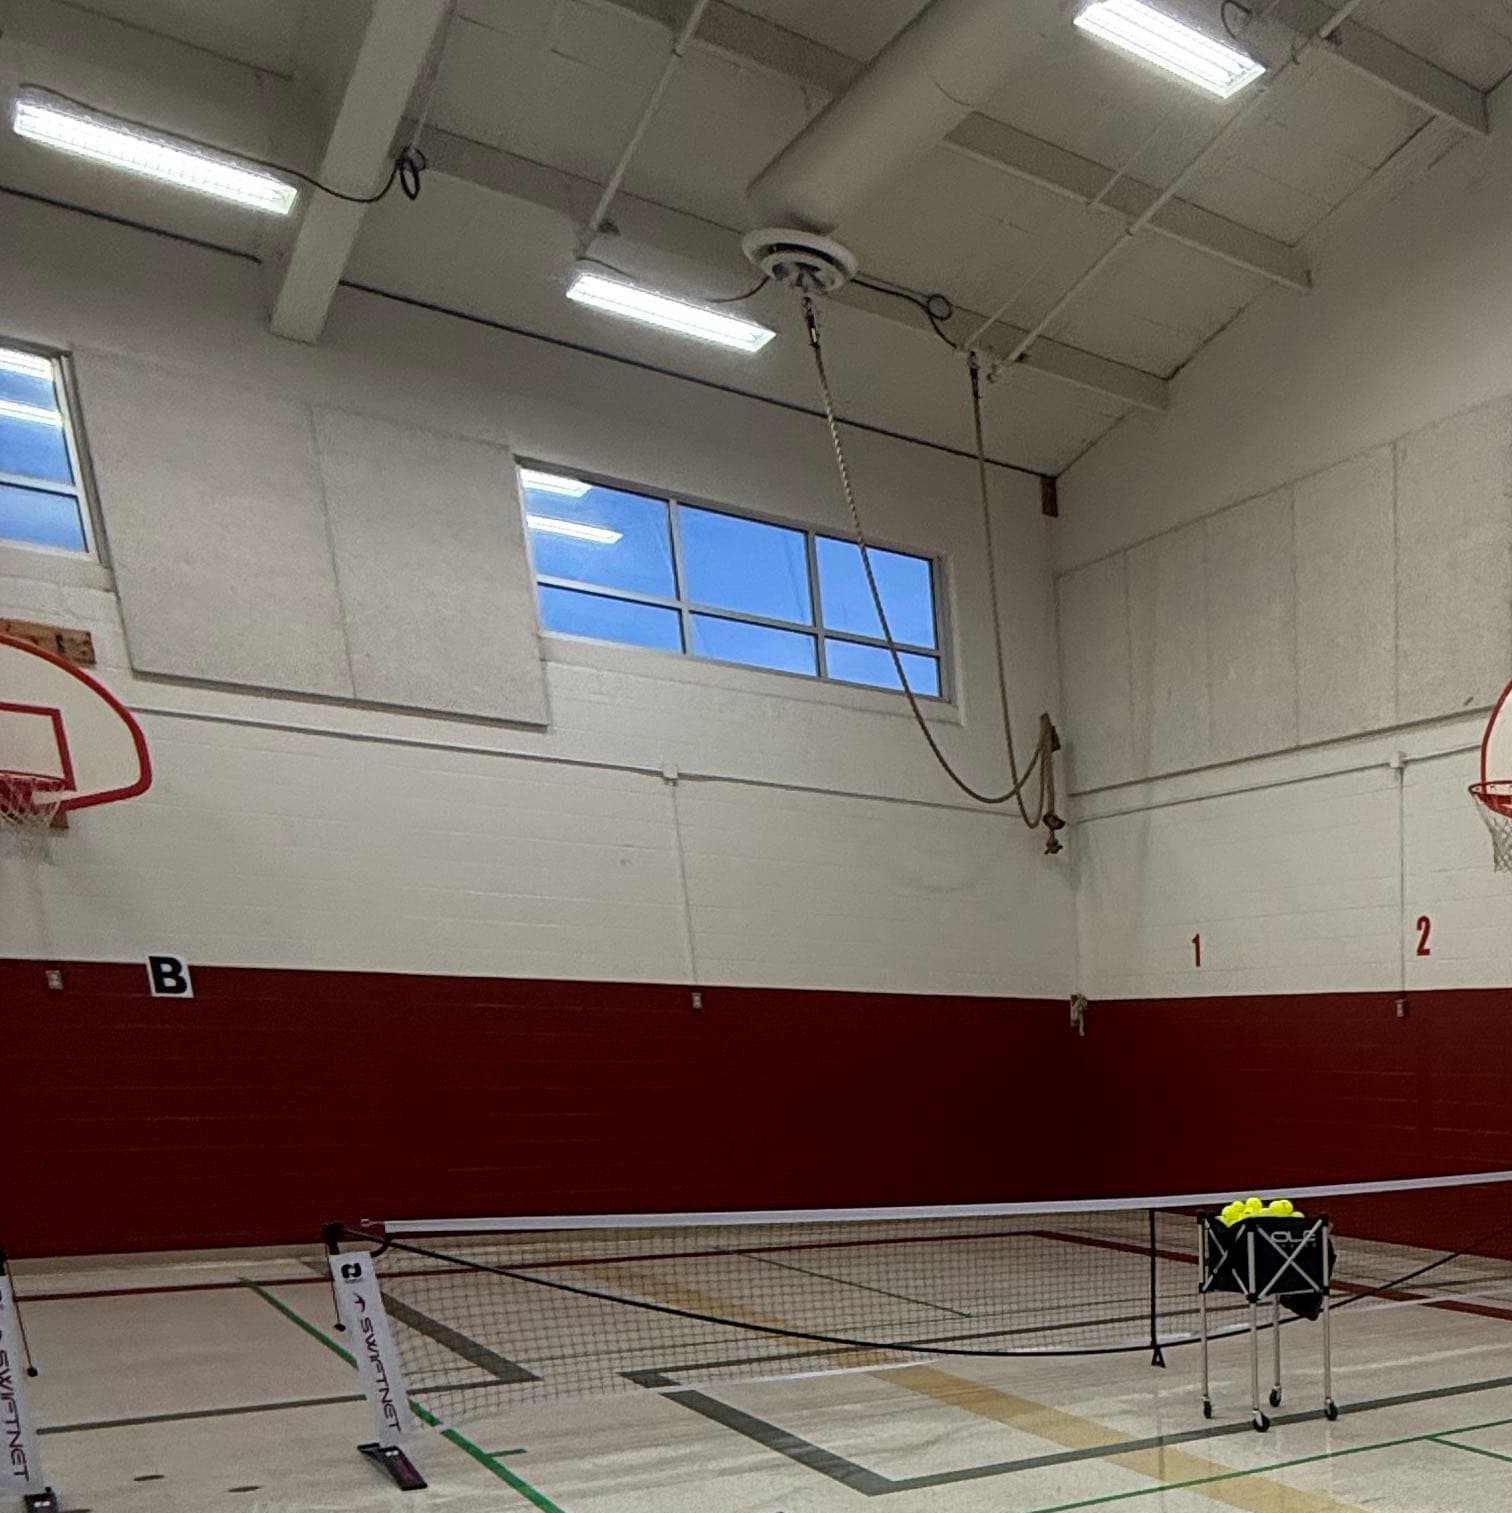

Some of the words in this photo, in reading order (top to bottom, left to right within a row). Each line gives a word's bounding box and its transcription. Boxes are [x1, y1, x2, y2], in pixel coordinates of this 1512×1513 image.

[1191, 933, 1202, 967] 1
[1416, 916, 1431, 956] 2
[149, 956, 187, 995] B
[360, 1316, 401, 1433] SWIFTNET
